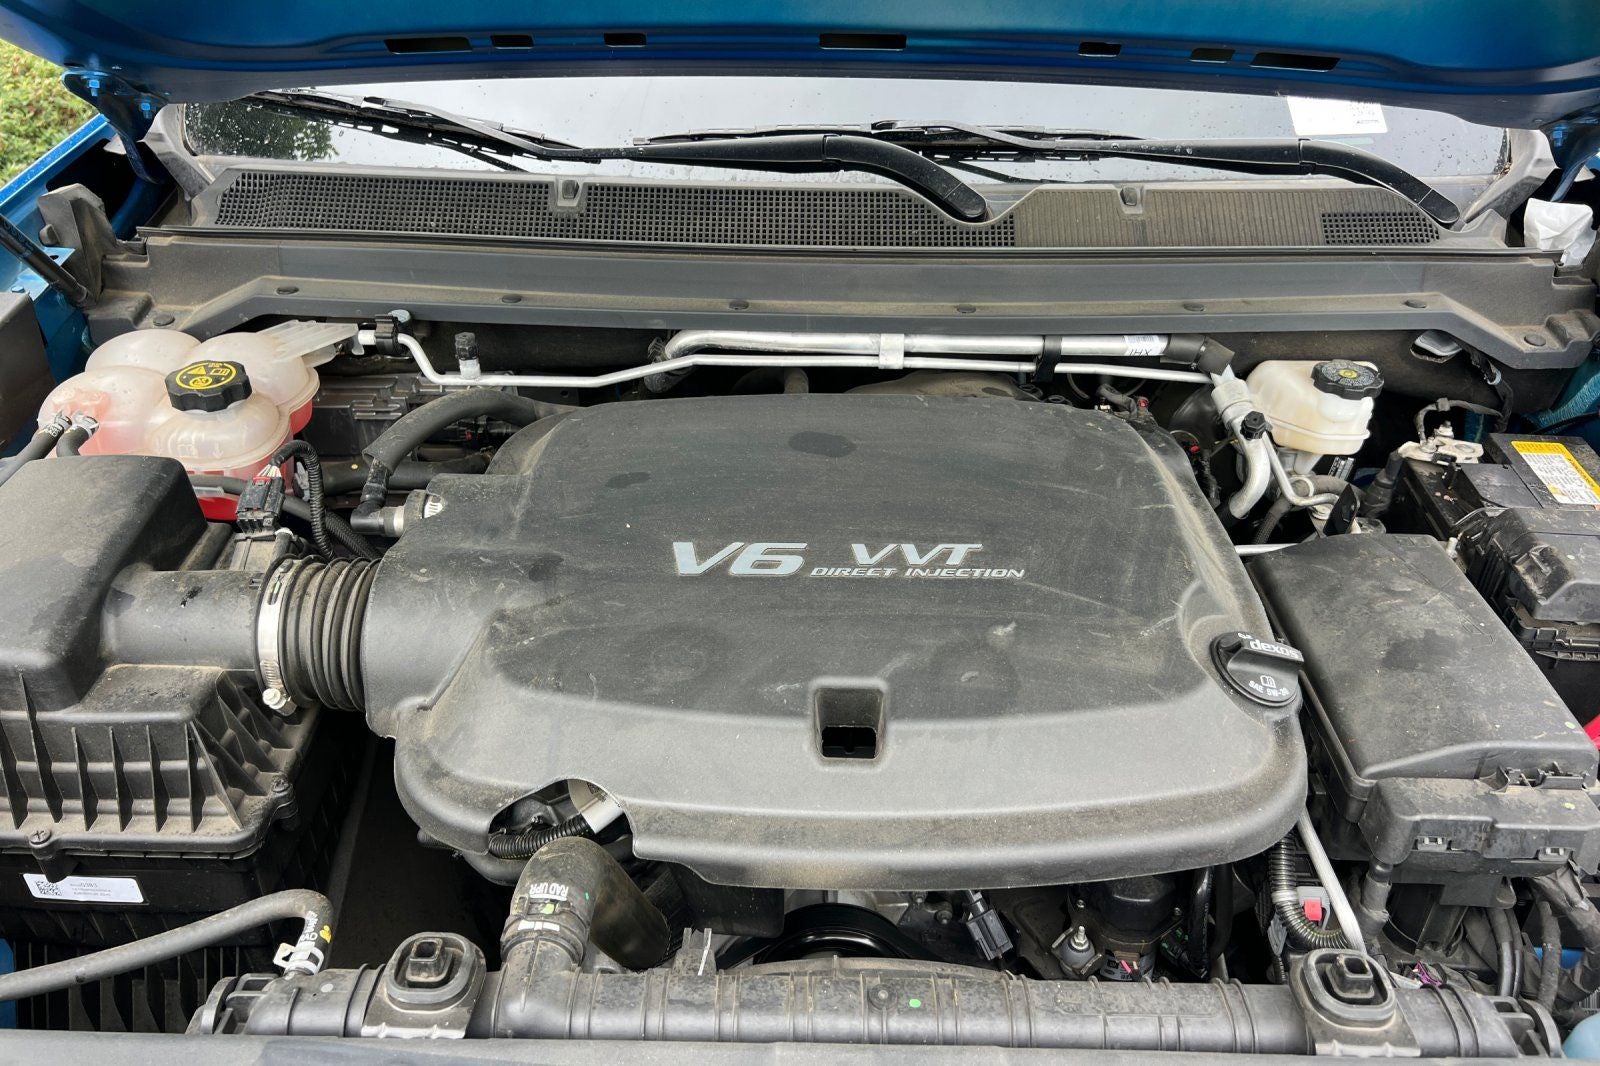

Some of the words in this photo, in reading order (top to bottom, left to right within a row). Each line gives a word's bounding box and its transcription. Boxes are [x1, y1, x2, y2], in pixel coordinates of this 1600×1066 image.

[672, 541, 808, 577] V6
[851, 542, 984, 566] VVT
[809, 567, 898, 578] DIRECT
[904, 567, 1026, 579] INJECTION
[1249, 639, 1300, 660] dexos
[1248, 680, 1264, 694] SAE
[549, 882, 569, 898] RAD
